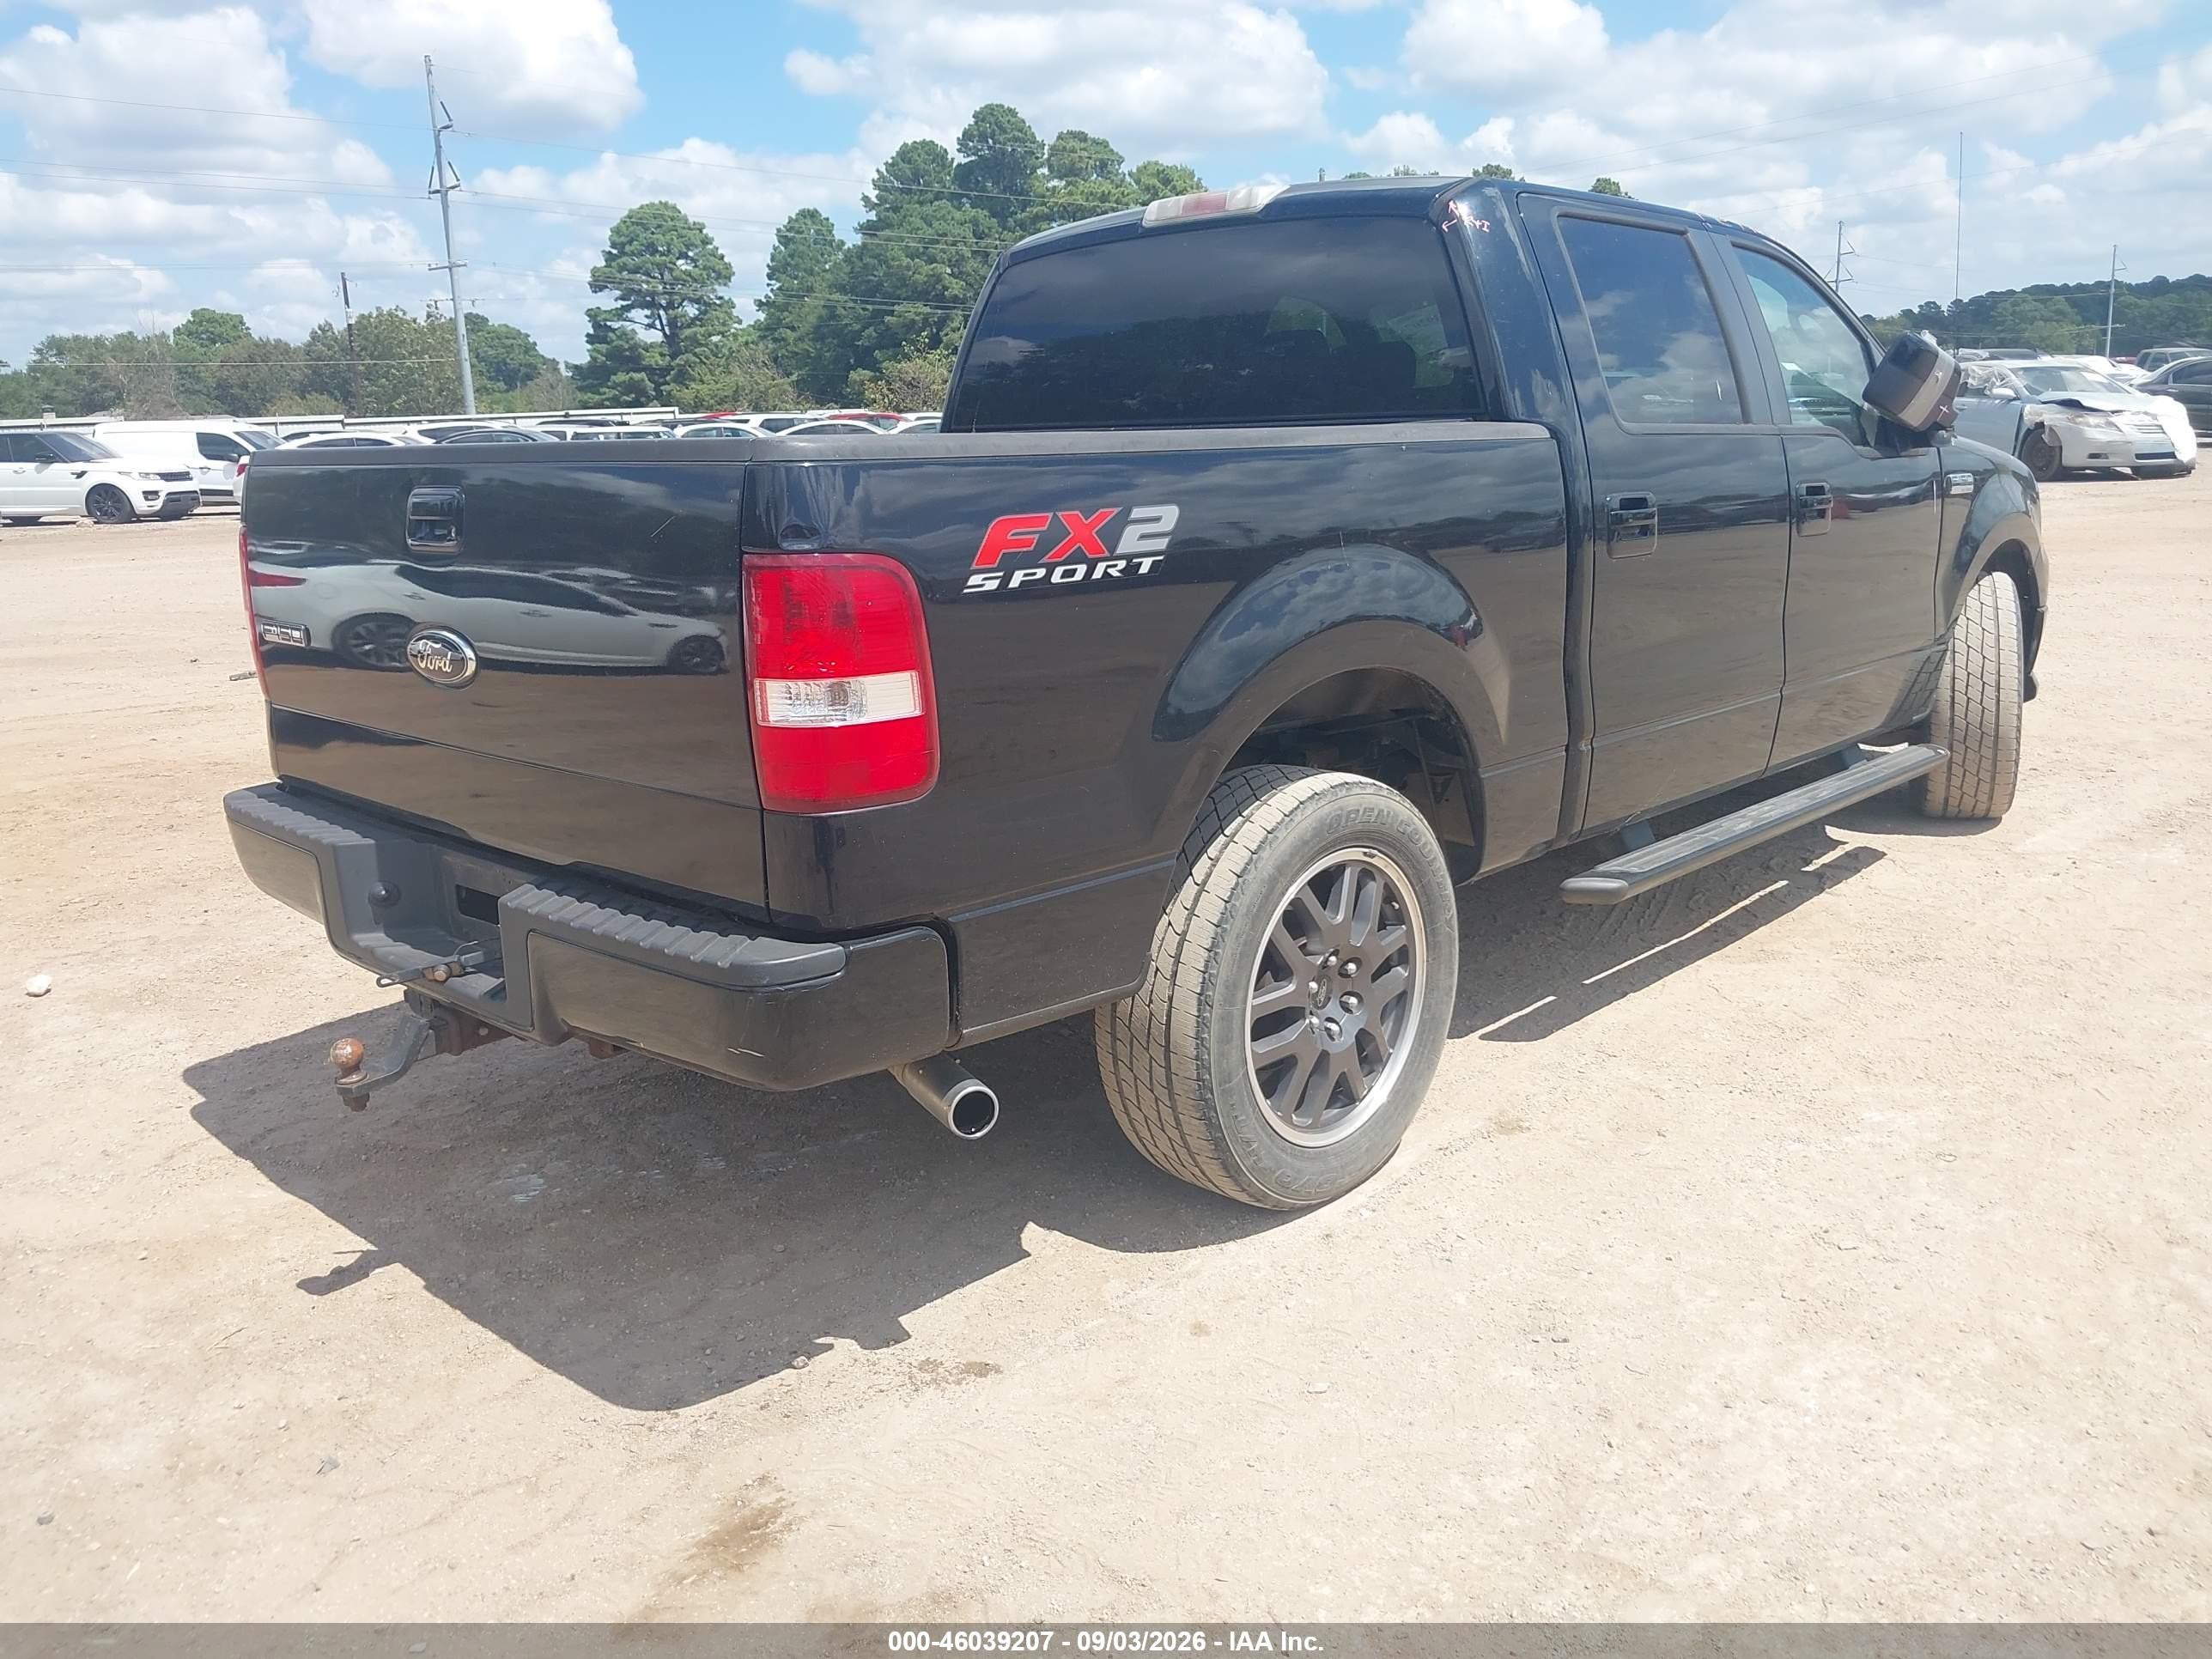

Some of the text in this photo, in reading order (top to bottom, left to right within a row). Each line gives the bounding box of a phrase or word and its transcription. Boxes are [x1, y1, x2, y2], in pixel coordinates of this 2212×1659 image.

[970, 503, 1179, 569] FX2
[962, 555, 1164, 593] SPORT
[417, 640, 453, 672] Ford
